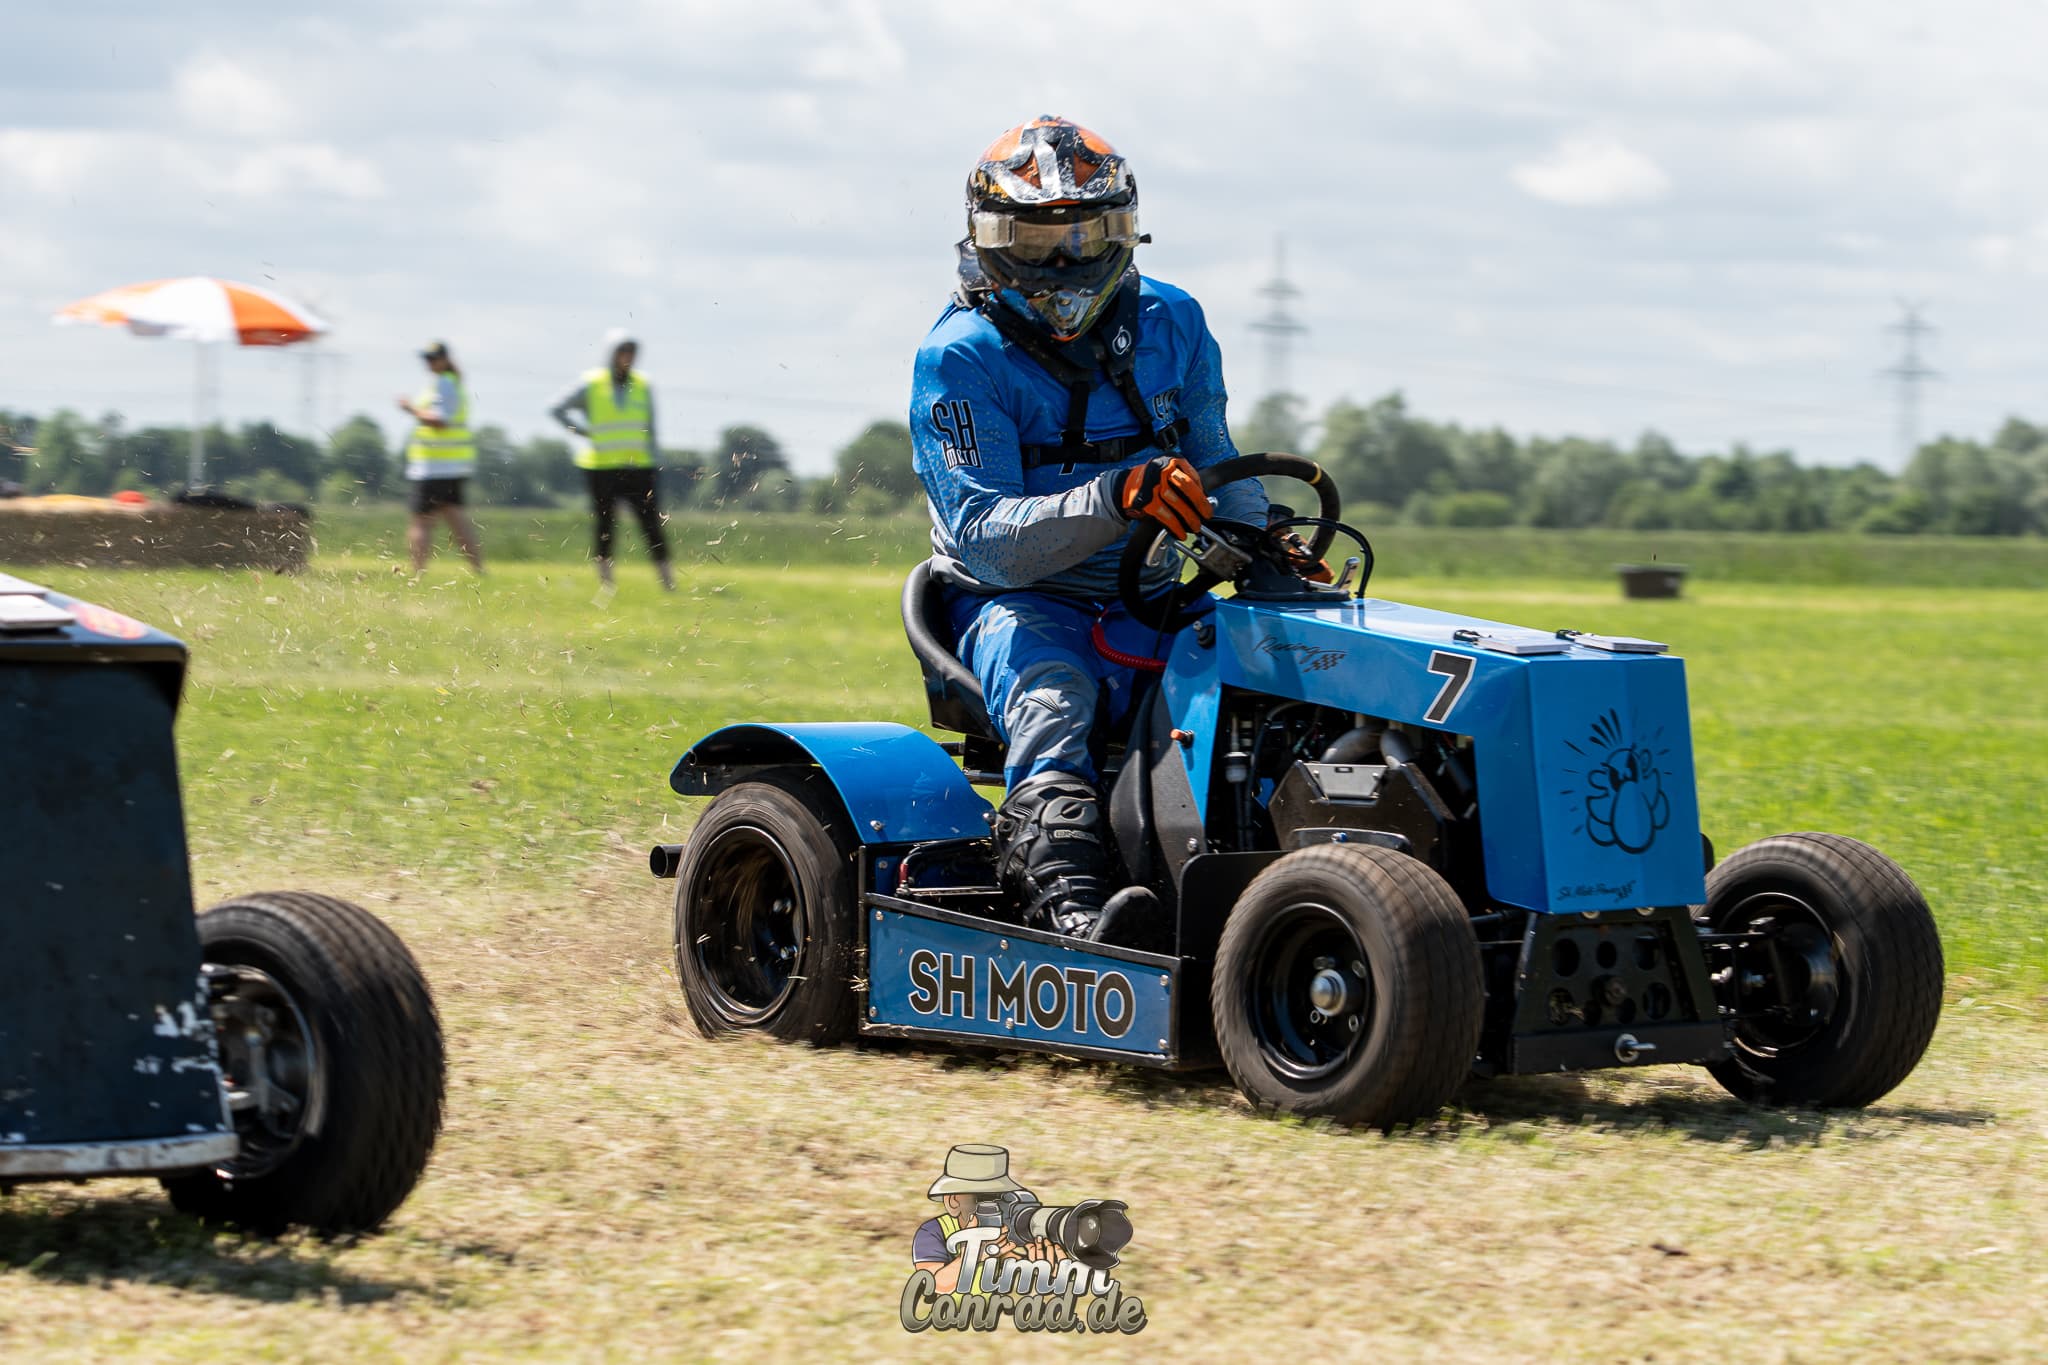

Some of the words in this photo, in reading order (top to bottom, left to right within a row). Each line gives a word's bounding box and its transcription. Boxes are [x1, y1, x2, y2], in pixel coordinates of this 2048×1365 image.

[931, 400, 978, 450] SH
[1422, 649, 1477, 724] 7
[908, 949, 975, 1020] SH
[987, 957, 1136, 1039] MOTO
